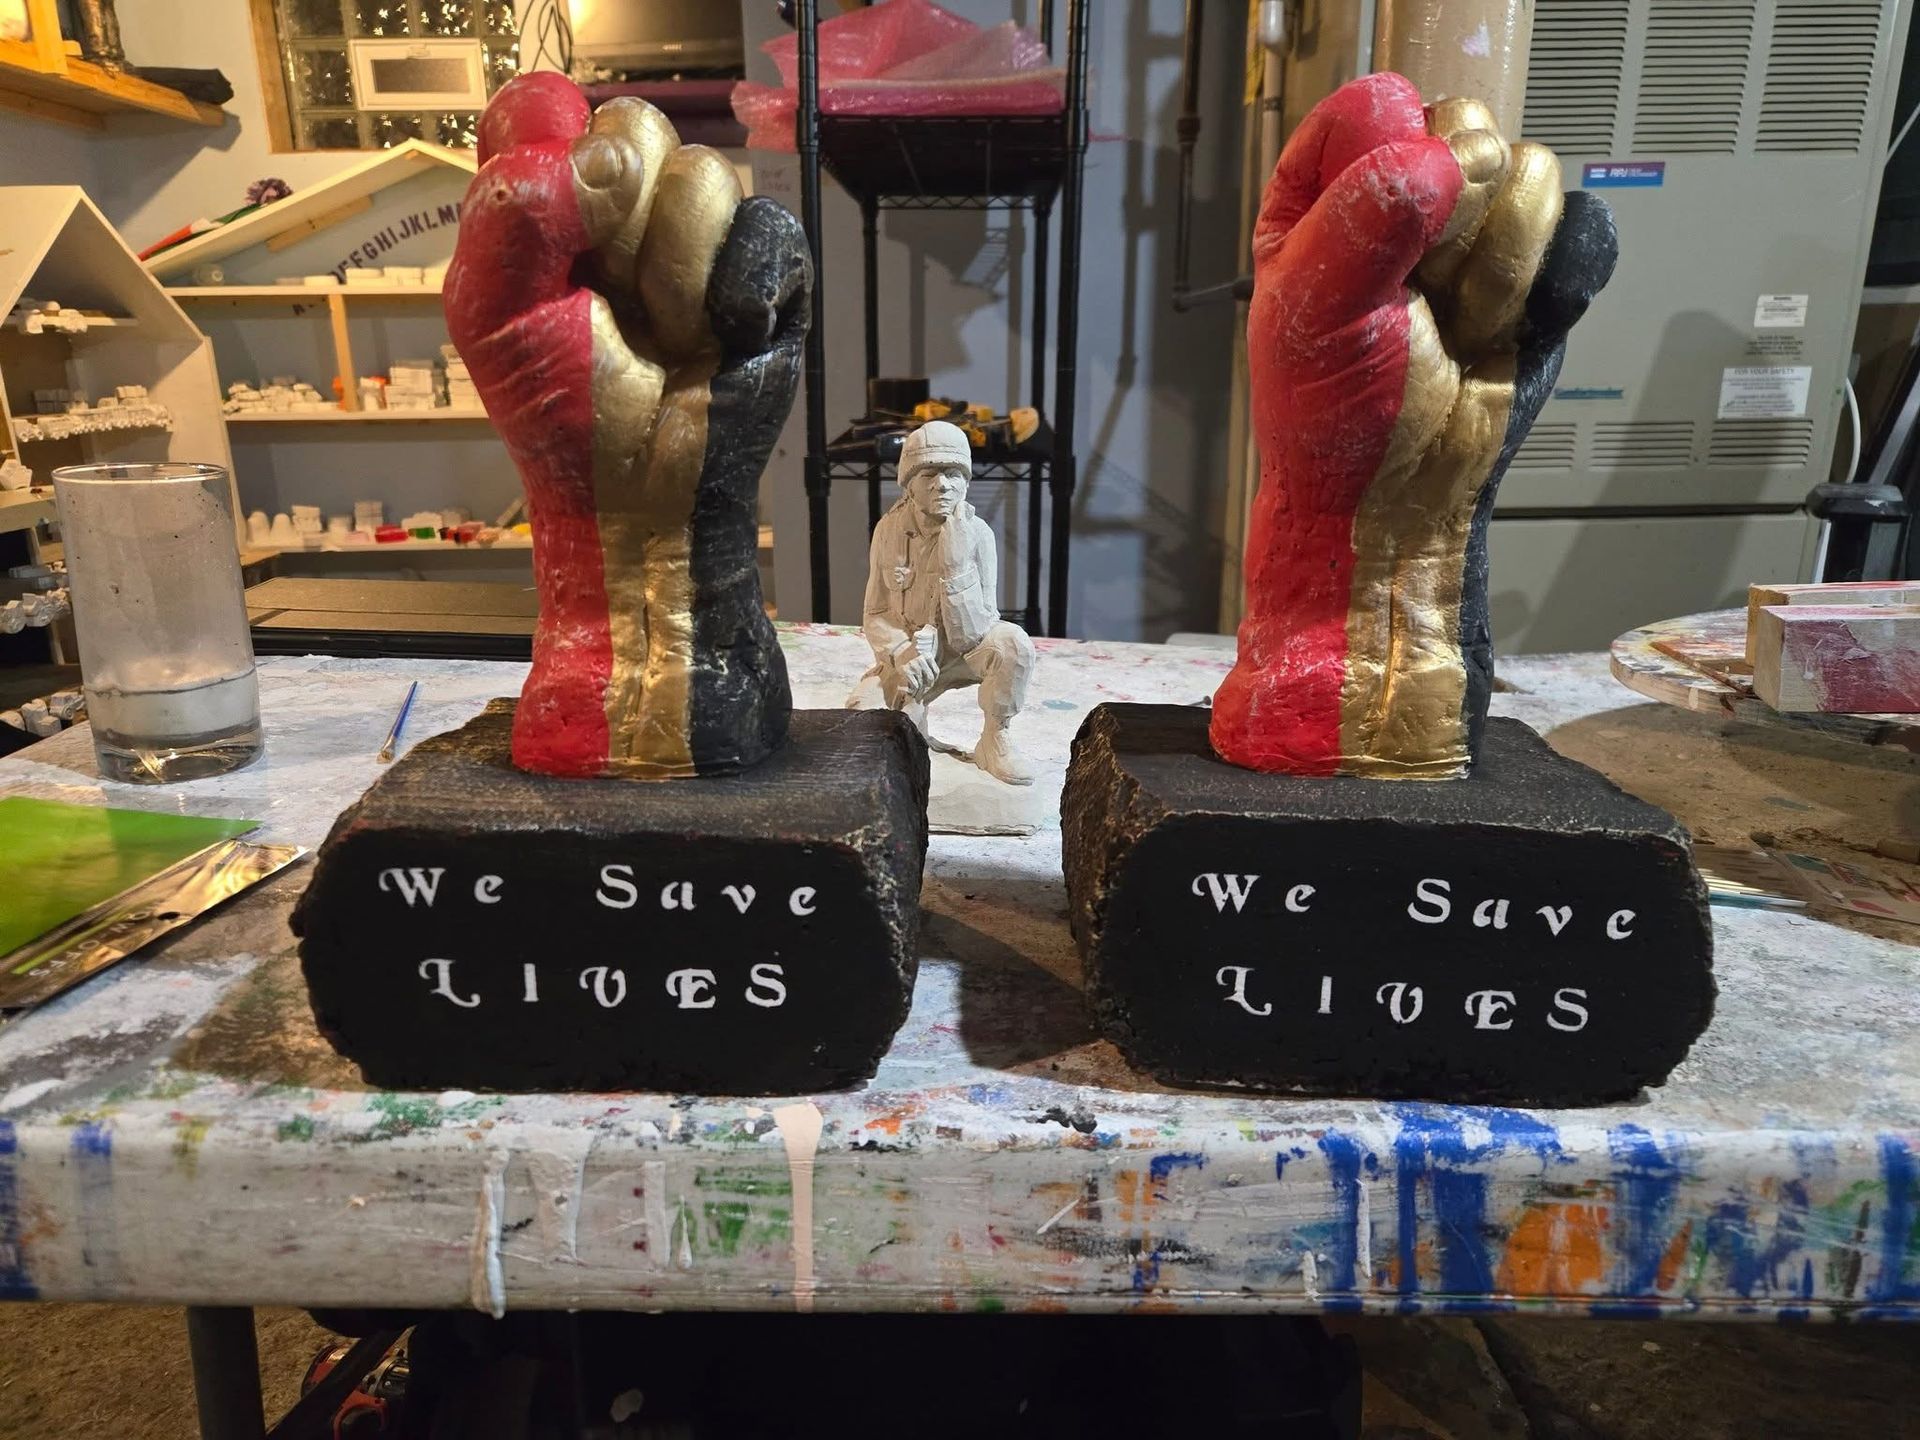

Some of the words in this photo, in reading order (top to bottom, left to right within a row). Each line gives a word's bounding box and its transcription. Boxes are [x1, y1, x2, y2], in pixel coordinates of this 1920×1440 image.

[378, 867, 504, 908] We
[596, 864, 817, 917] Save
[1191, 872, 1317, 914] We
[1406, 877, 1637, 941] Save
[418, 957, 788, 1009] LIVES
[1215, 965, 1590, 1033] LIVES
